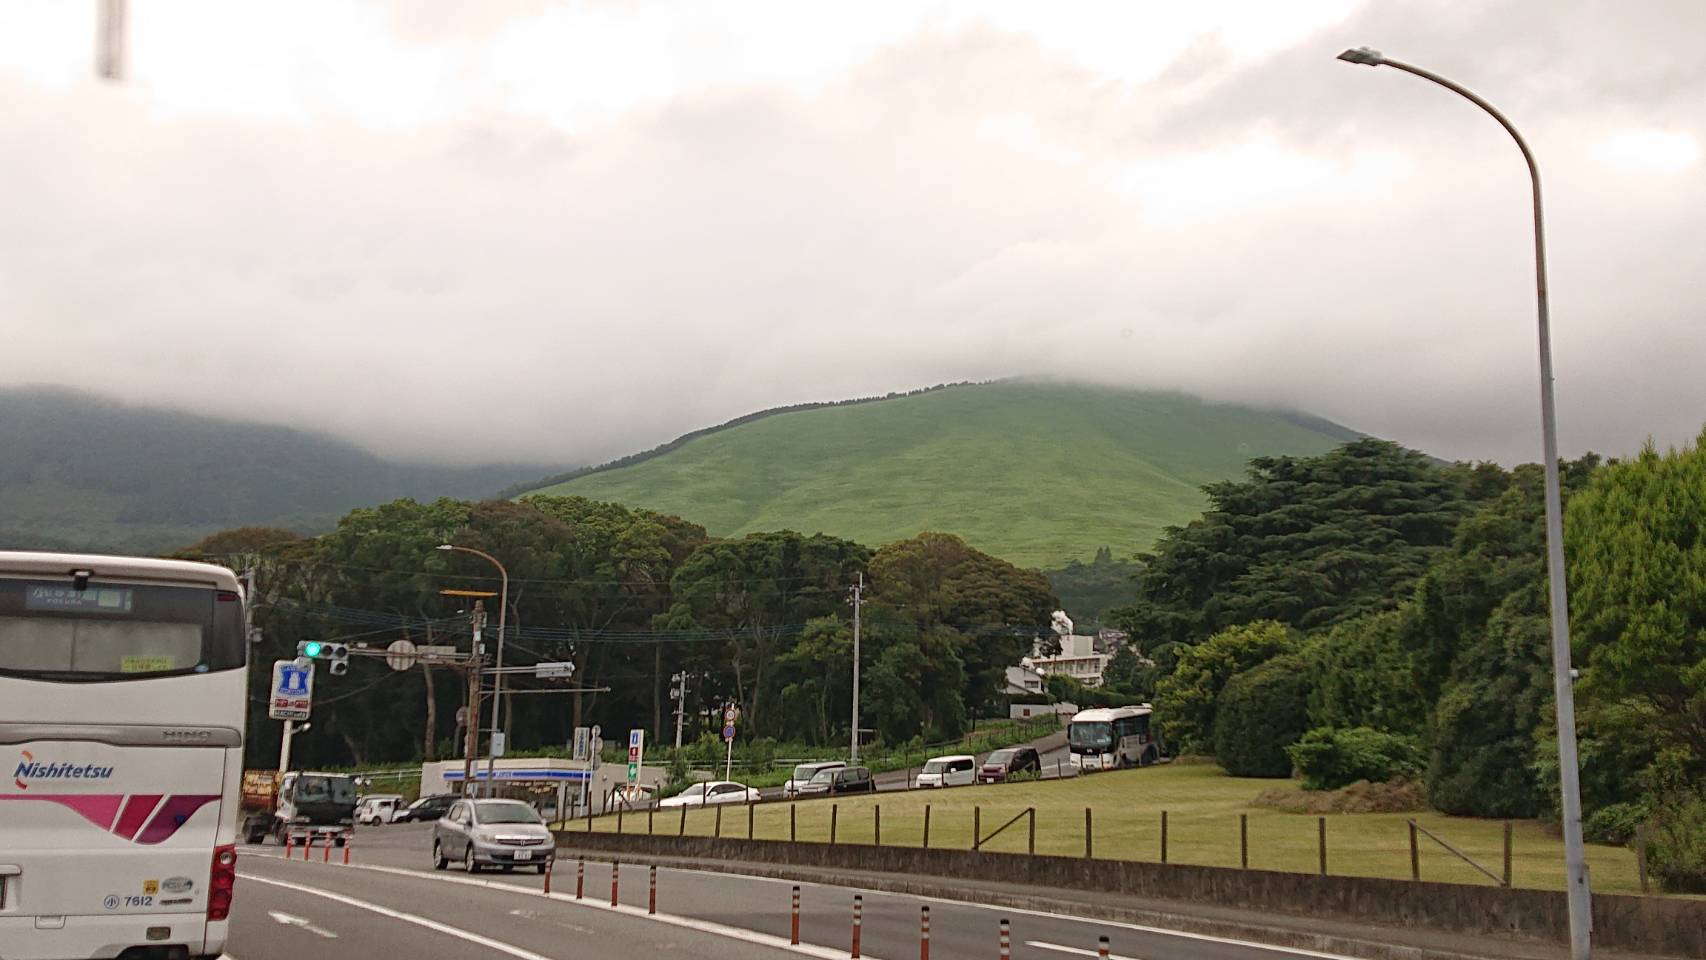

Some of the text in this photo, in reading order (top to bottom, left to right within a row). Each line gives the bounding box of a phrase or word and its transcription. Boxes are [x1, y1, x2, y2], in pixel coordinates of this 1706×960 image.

[162, 730, 211, 739] HINO
[14, 761, 114, 778] Nishitetsu
[124, 896, 152, 906] 7612
